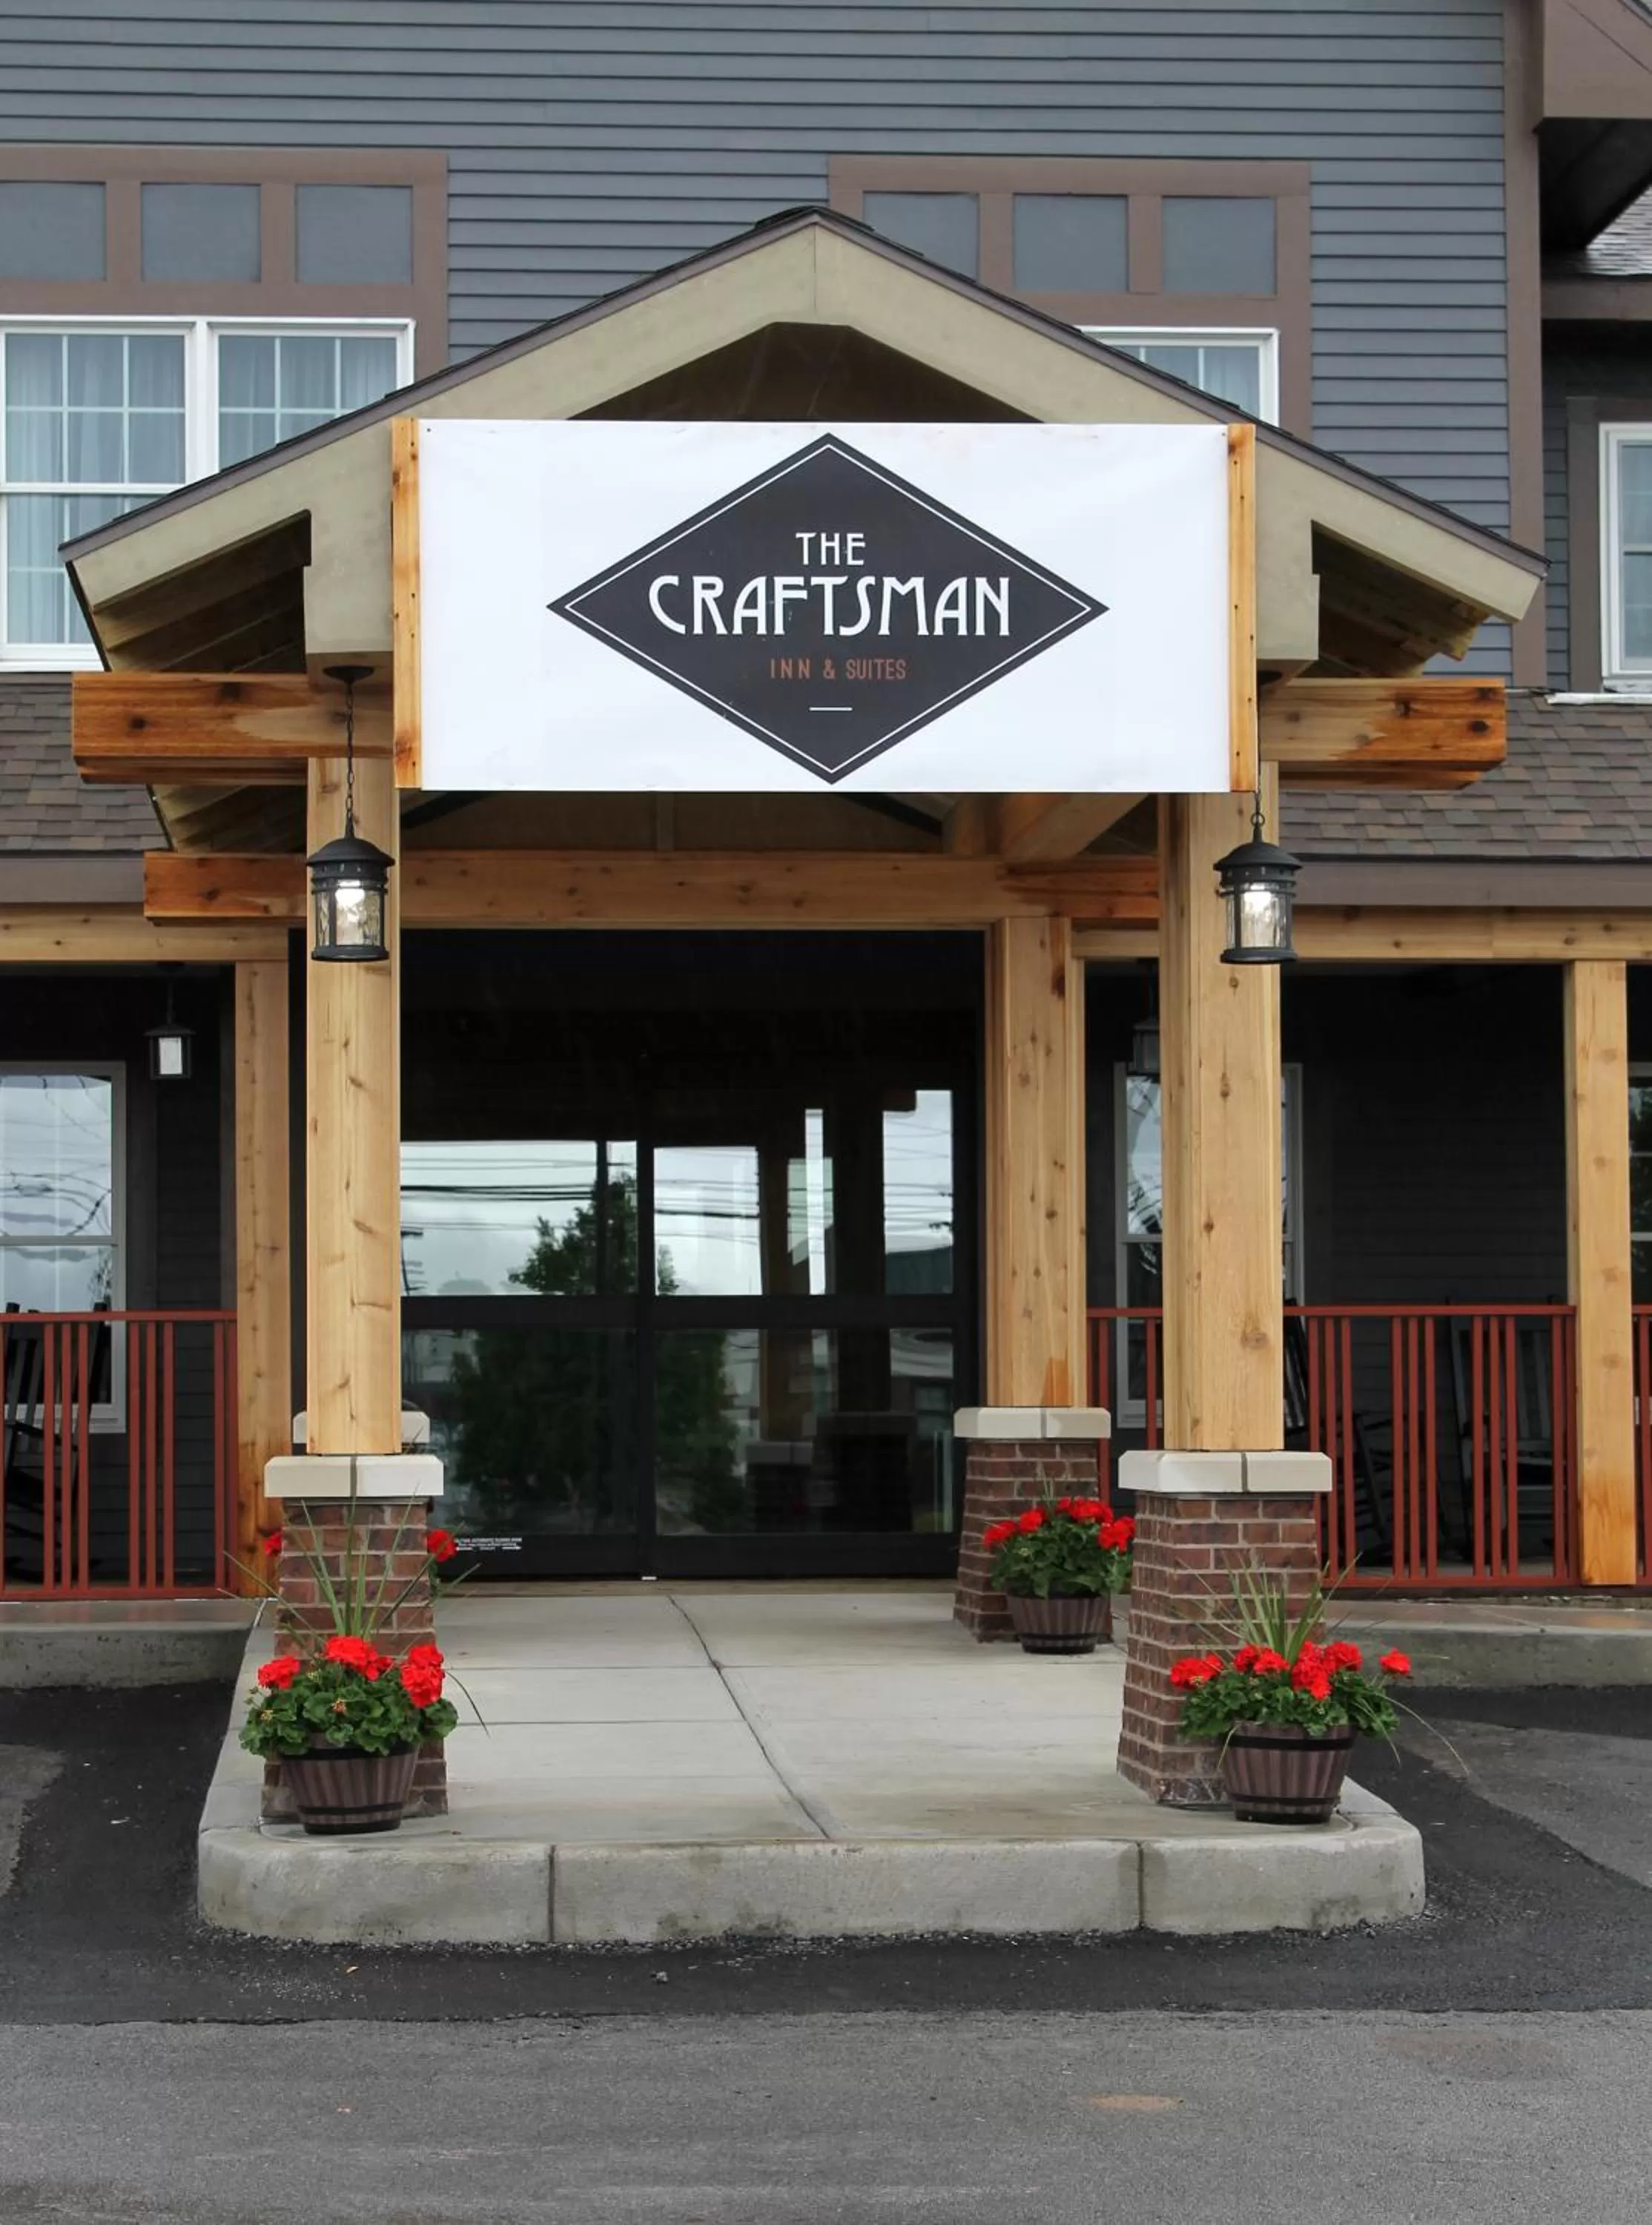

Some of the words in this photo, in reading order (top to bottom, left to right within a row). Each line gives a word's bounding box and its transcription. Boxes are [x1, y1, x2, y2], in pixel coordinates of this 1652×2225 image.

[795, 532, 867, 566] THE
[648, 575, 1011, 636] CRAFTSMAN
[770, 658, 812, 680] INN
[822, 659, 836, 679] &
[845, 658, 908, 680] SUITES
